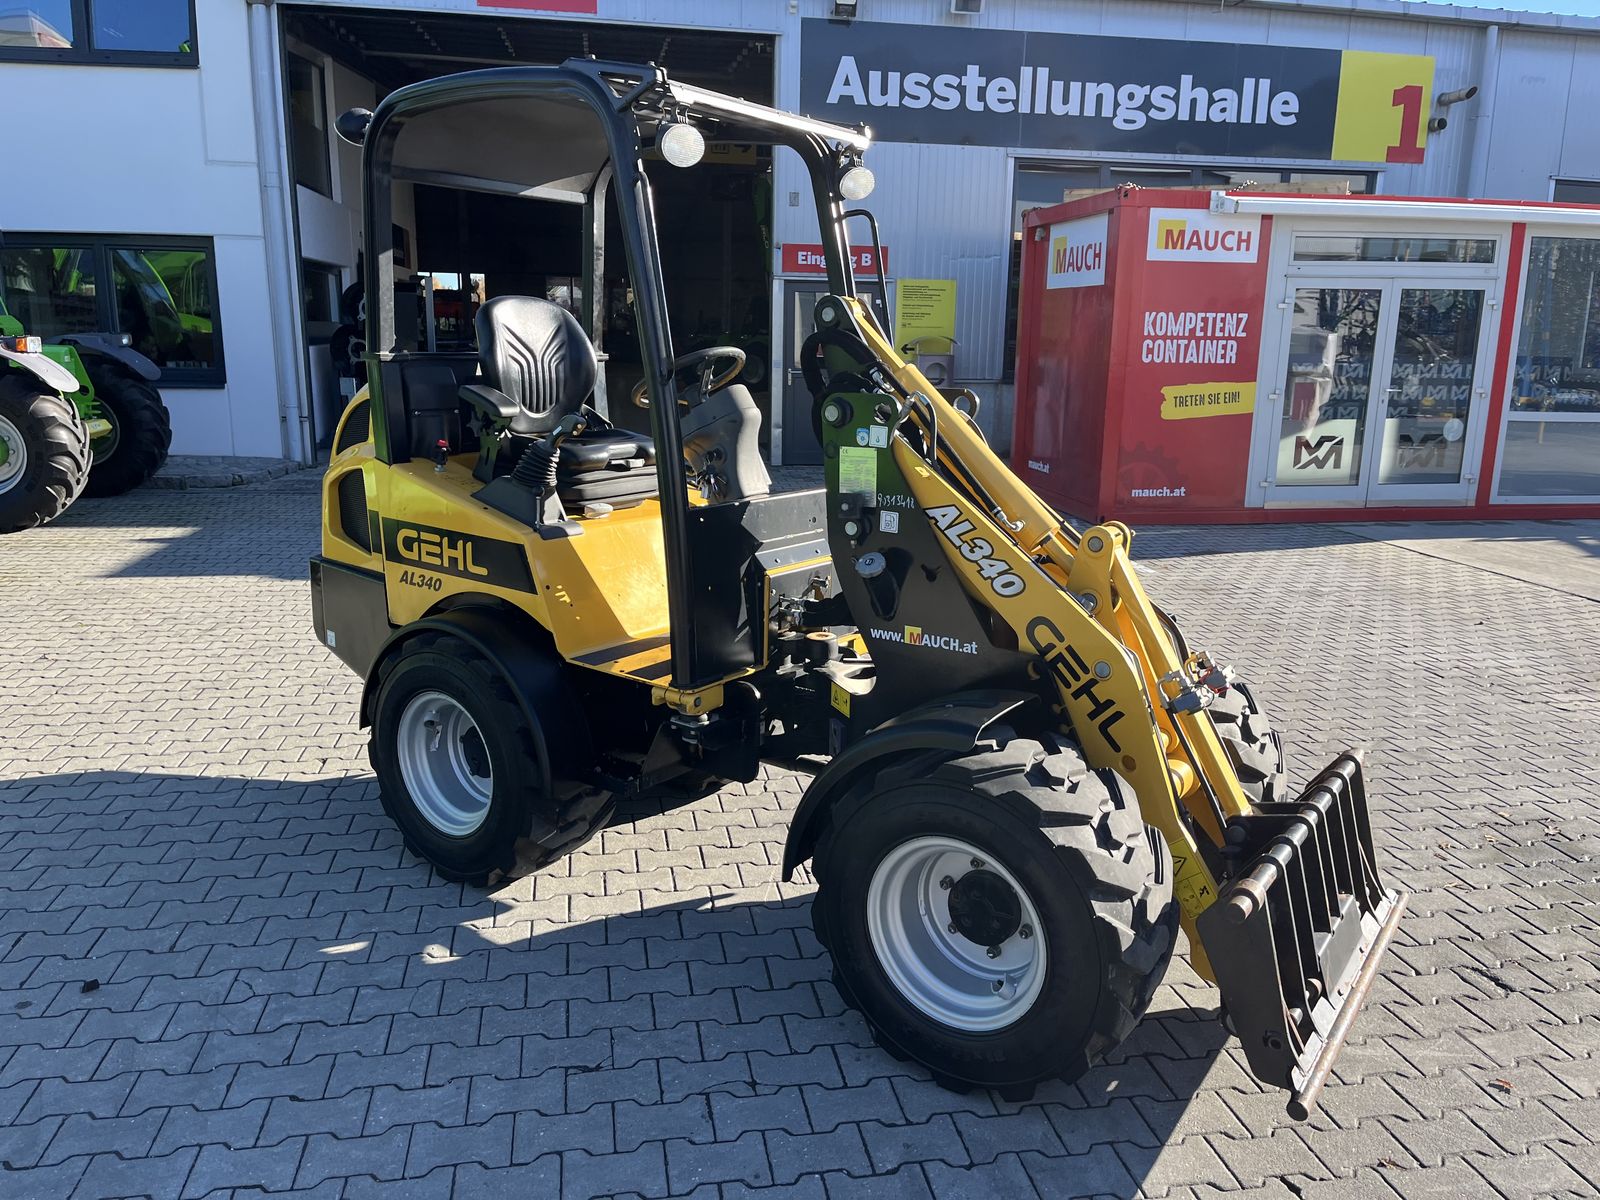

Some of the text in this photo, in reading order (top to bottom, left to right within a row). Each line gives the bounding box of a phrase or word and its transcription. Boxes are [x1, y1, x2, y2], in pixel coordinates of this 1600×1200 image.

[825, 55, 1426, 165] Ausstellungshalle 1
[1163, 228, 1252, 252] MAUCH
[797, 251, 872, 269] Eingg B
[1054, 242, 1101, 274] MAUCH
[1143, 311, 1249, 338] KOMPETENZ
[1141, 338, 1238, 364] CONTAINER
[1173, 391, 1241, 408] TRETEN SIE EIN!
[1131, 486, 1186, 497] mauch.at
[396, 527, 488, 576] GEHL
[924, 505, 1026, 598] AL340
[399, 570, 443, 592] AL340
[870, 627, 978, 654] www.MAUCH.at
[1025, 615, 1126, 754] GEHL
